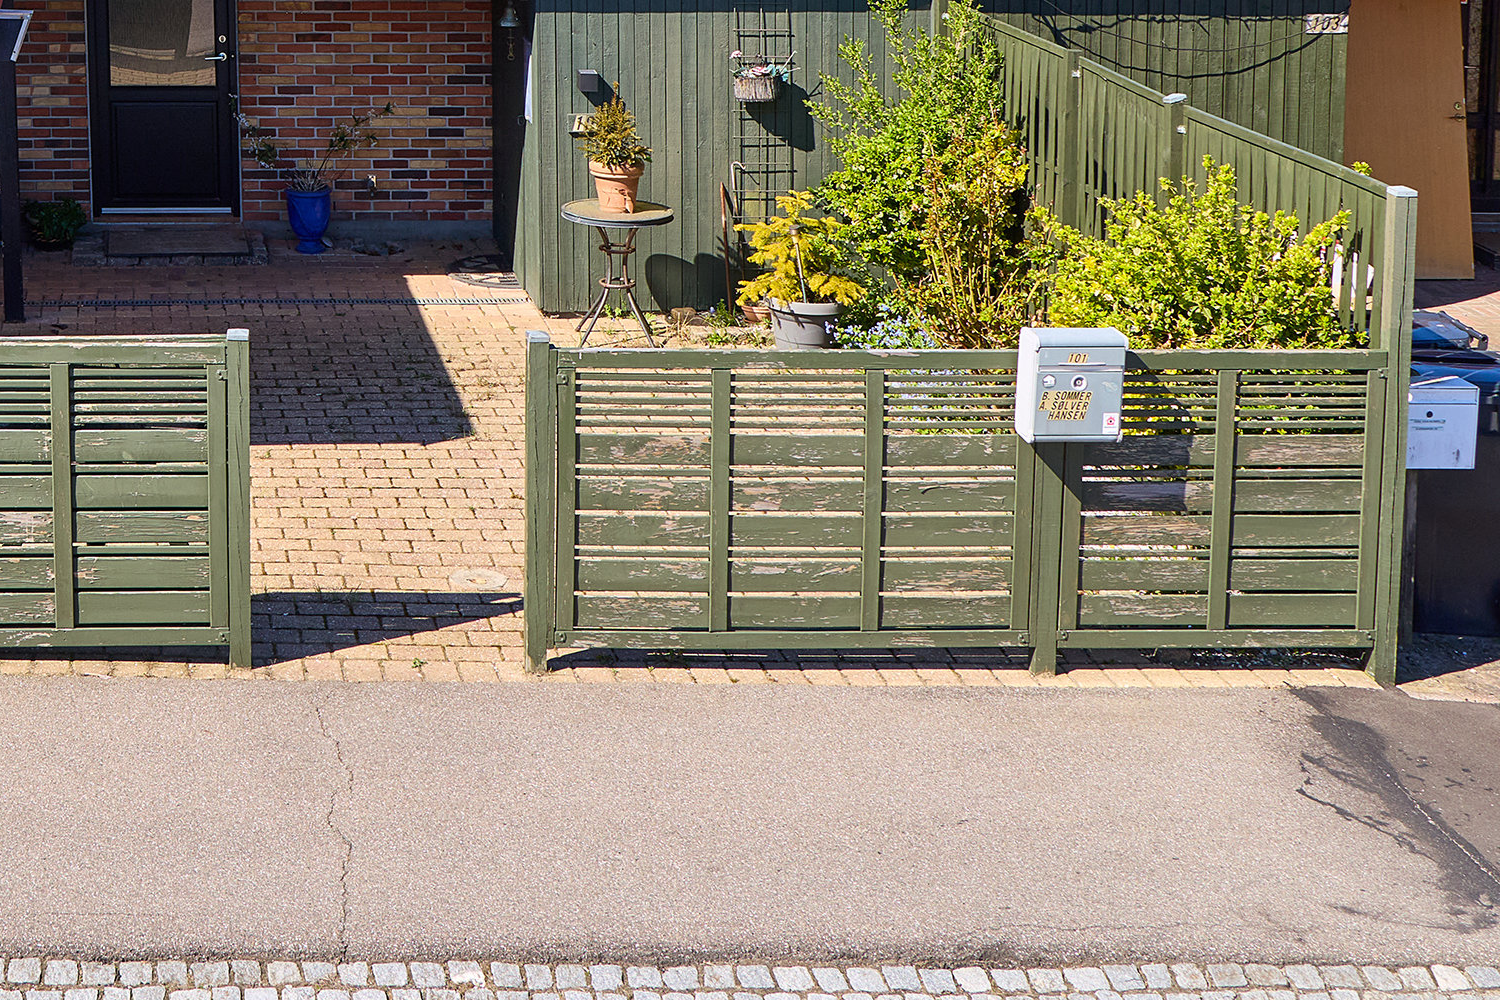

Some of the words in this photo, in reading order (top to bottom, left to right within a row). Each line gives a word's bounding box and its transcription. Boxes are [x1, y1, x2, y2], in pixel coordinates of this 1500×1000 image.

[1313, 16, 1340, 30] 103
[1069, 353, 1087, 363] 101
[1054, 391, 1092, 400] SOMMER
[1051, 401, 1089, 410] SØLVER
[1048, 411, 1087, 420] HANSEN
